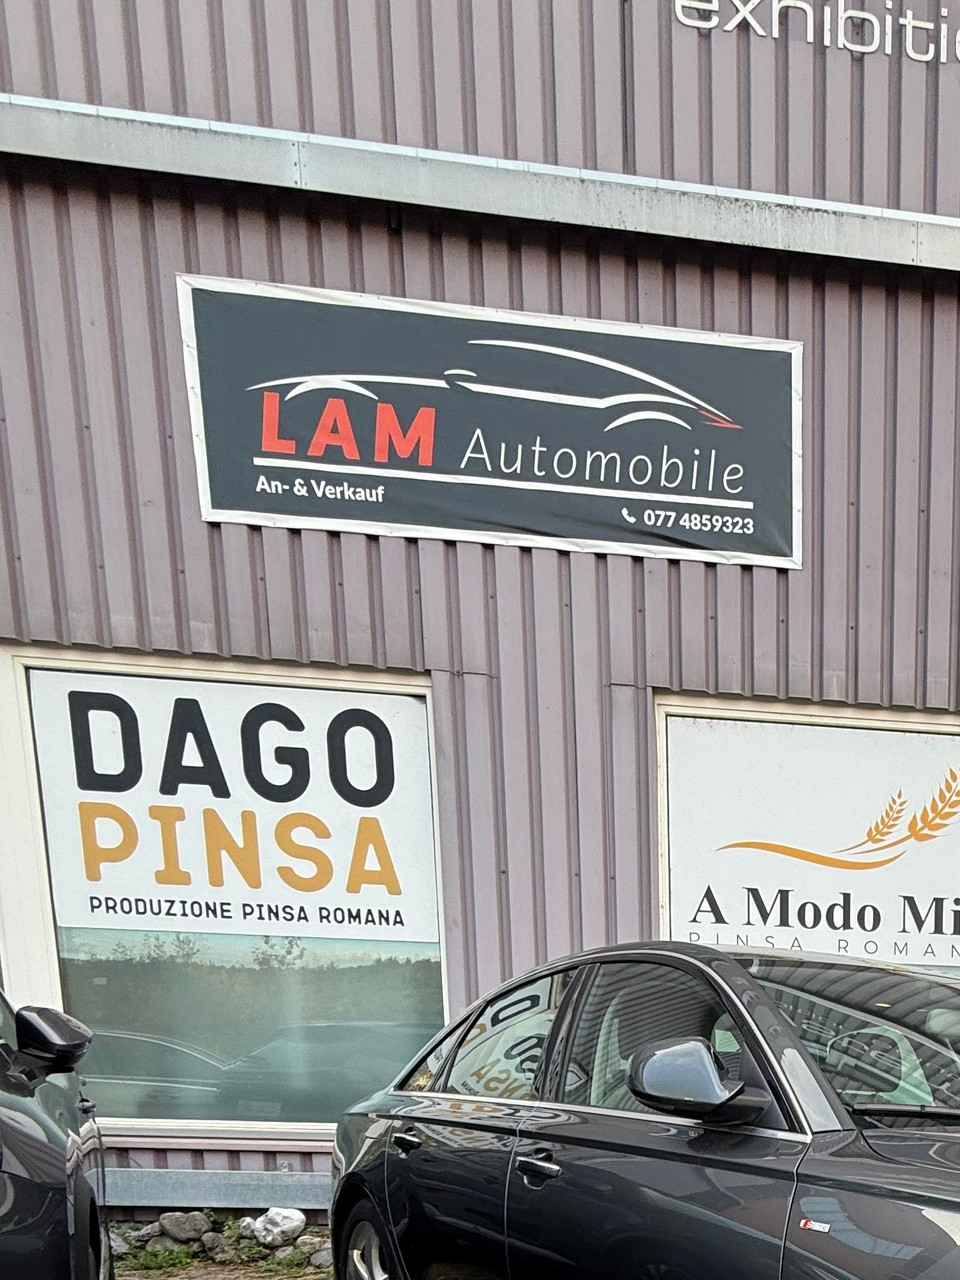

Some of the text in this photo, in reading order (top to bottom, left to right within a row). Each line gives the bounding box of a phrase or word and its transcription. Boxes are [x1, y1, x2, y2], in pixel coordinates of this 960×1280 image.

[261, 391, 745, 494] LAM Automobile
[256, 474, 385, 502] An- & Verkauf
[643, 510, 755, 534] 077 4859323
[68, 690, 395, 808] DAGO
[78, 801, 402, 896] PINSA
[89, 896, 405, 927] PRODUZIONE PINSA ROMANA
[689, 884, 730, 925] A
[742, 886, 881, 932] Modo
[689, 932, 803, 951] PINSA
